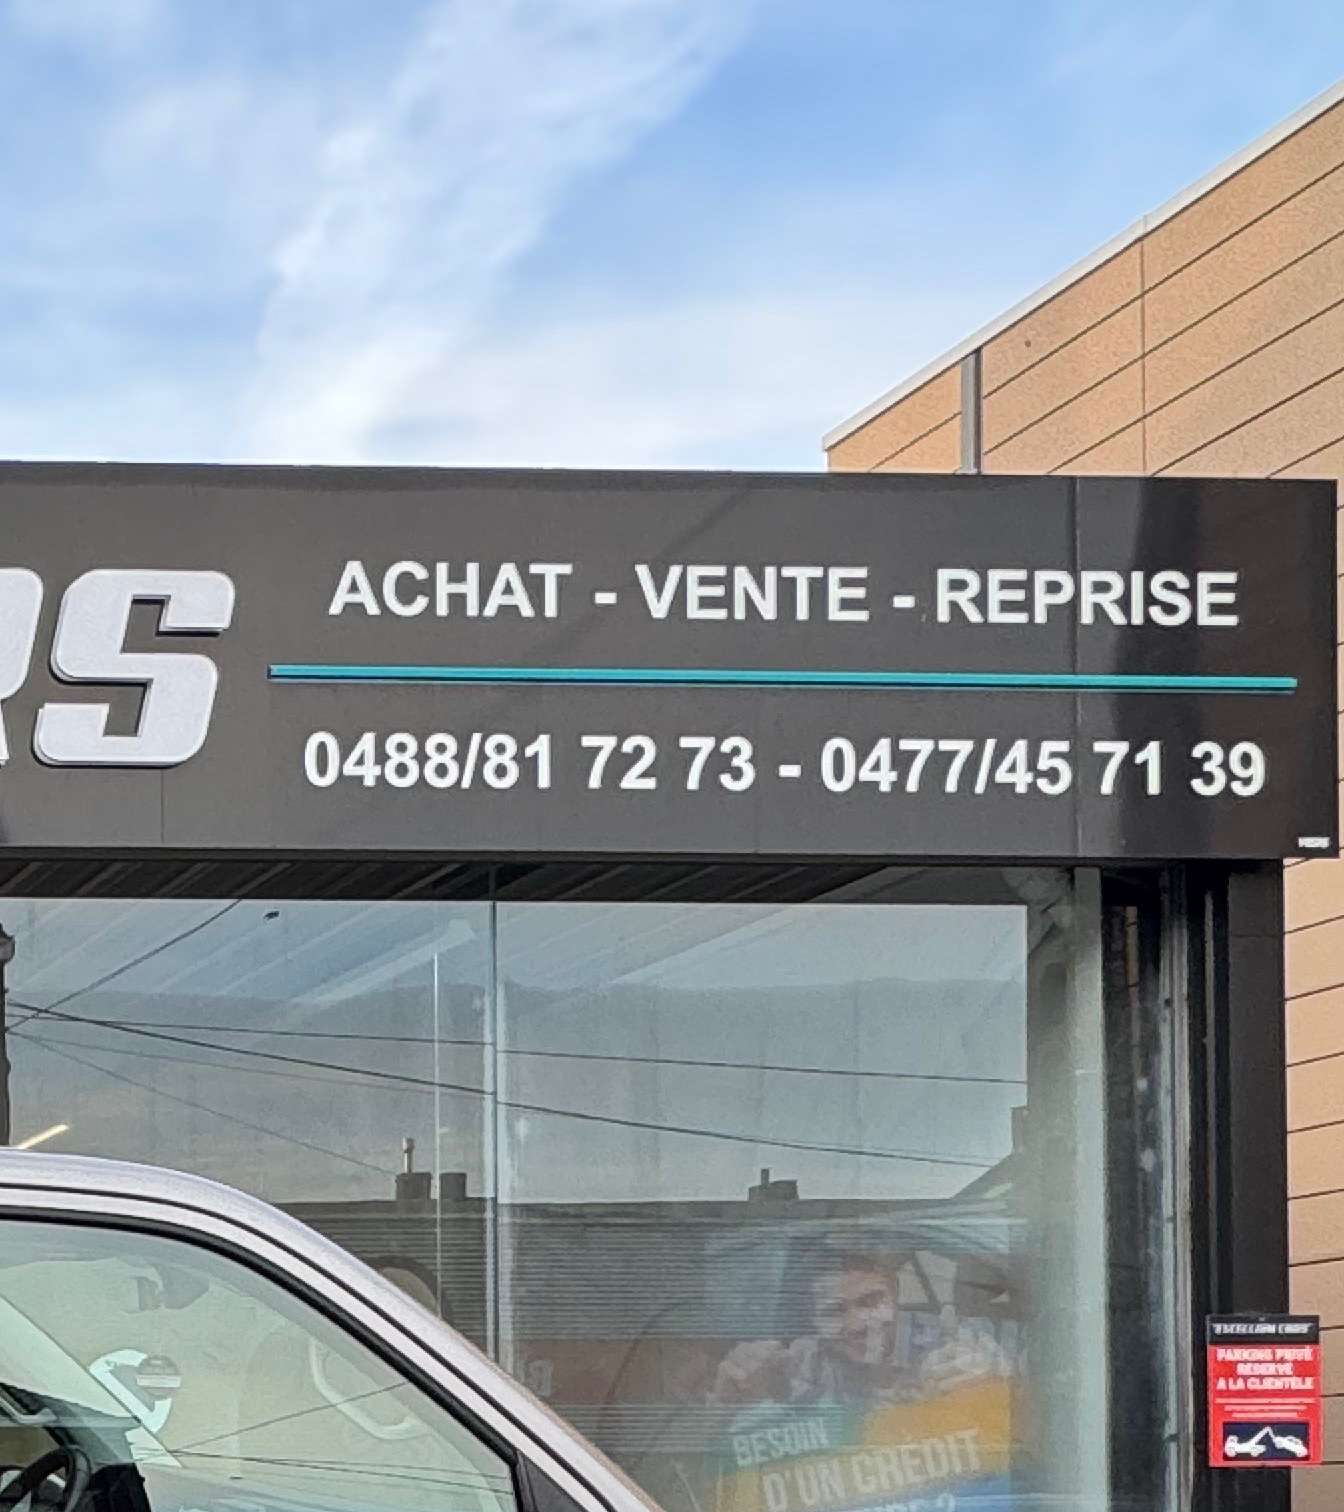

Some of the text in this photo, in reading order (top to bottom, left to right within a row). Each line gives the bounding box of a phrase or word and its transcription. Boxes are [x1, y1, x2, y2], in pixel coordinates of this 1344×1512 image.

[327, 560, 573, 618] ACHAT
[634, 563, 870, 622] VENTE
[936, 567, 1239, 627] REPRISE
[303, 730, 553, 790] 0488/81
[579, 734, 657, 791] 72
[678, 735, 756, 792] 73
[820, 736, 1073, 796] 0477/45
[1092, 740, 1163, 797] 71
[1190, 741, 1267, 797] 39
[1228, 1377, 1246, 1389] LA
[732, 1416, 830, 1467] BESOIN
